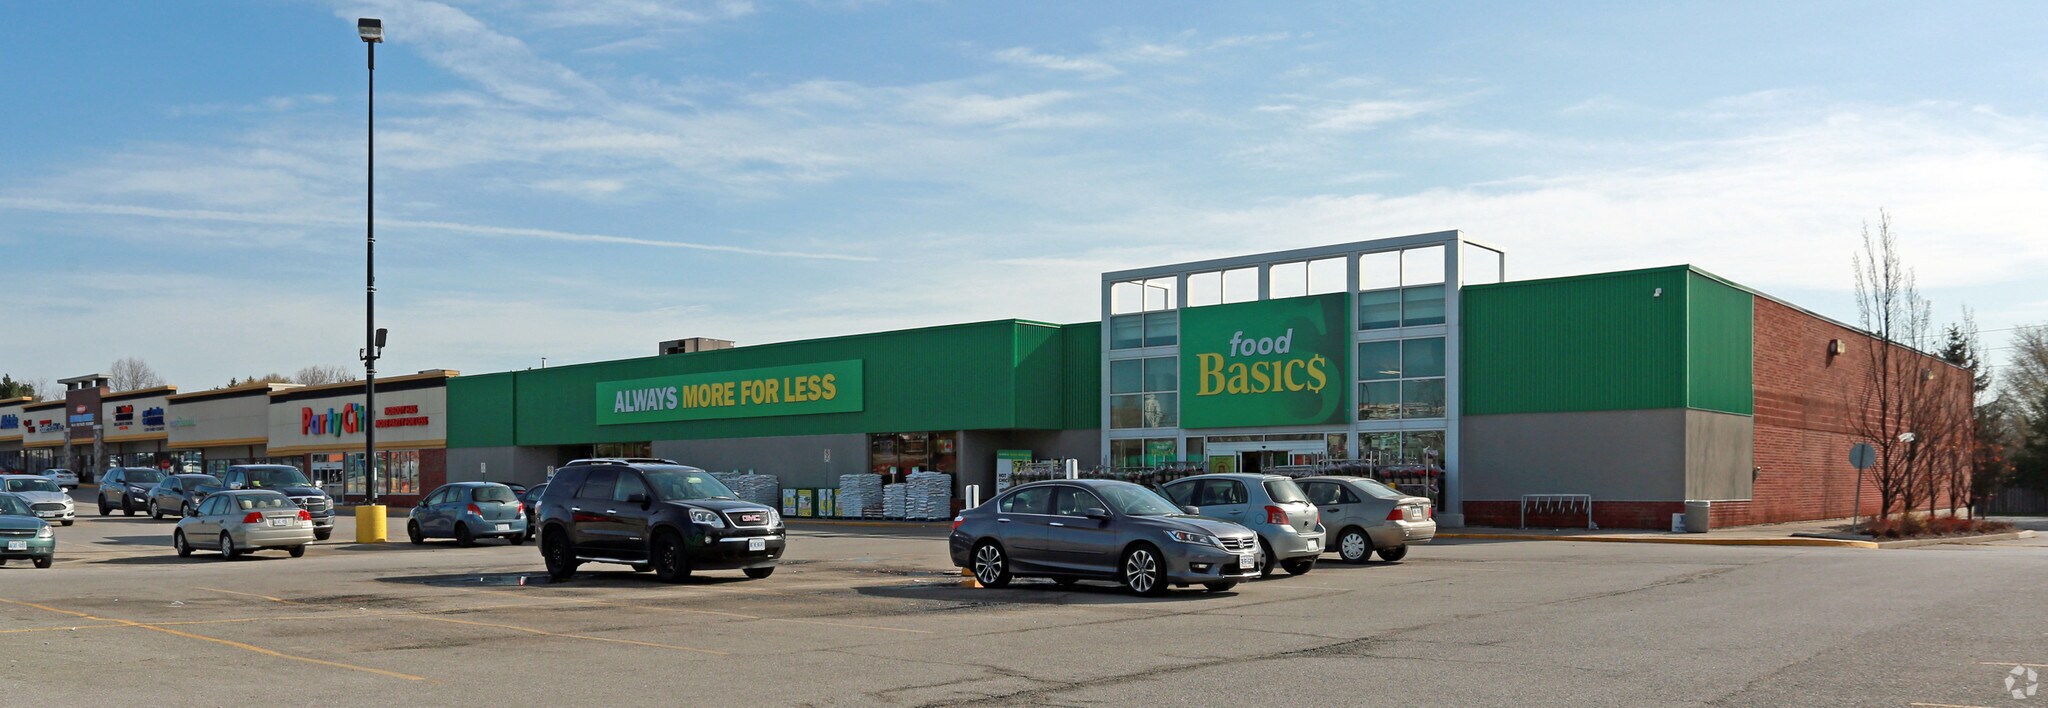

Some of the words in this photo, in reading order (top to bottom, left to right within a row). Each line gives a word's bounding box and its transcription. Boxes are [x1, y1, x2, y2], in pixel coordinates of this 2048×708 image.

[1229, 328, 1293, 357] food
[614, 386, 677, 413] ALWAYS
[682, 381, 735, 409] MORE
[740, 378, 779, 405] FOR
[784, 373, 837, 403] LESS
[342, 402, 367, 433] Cit
